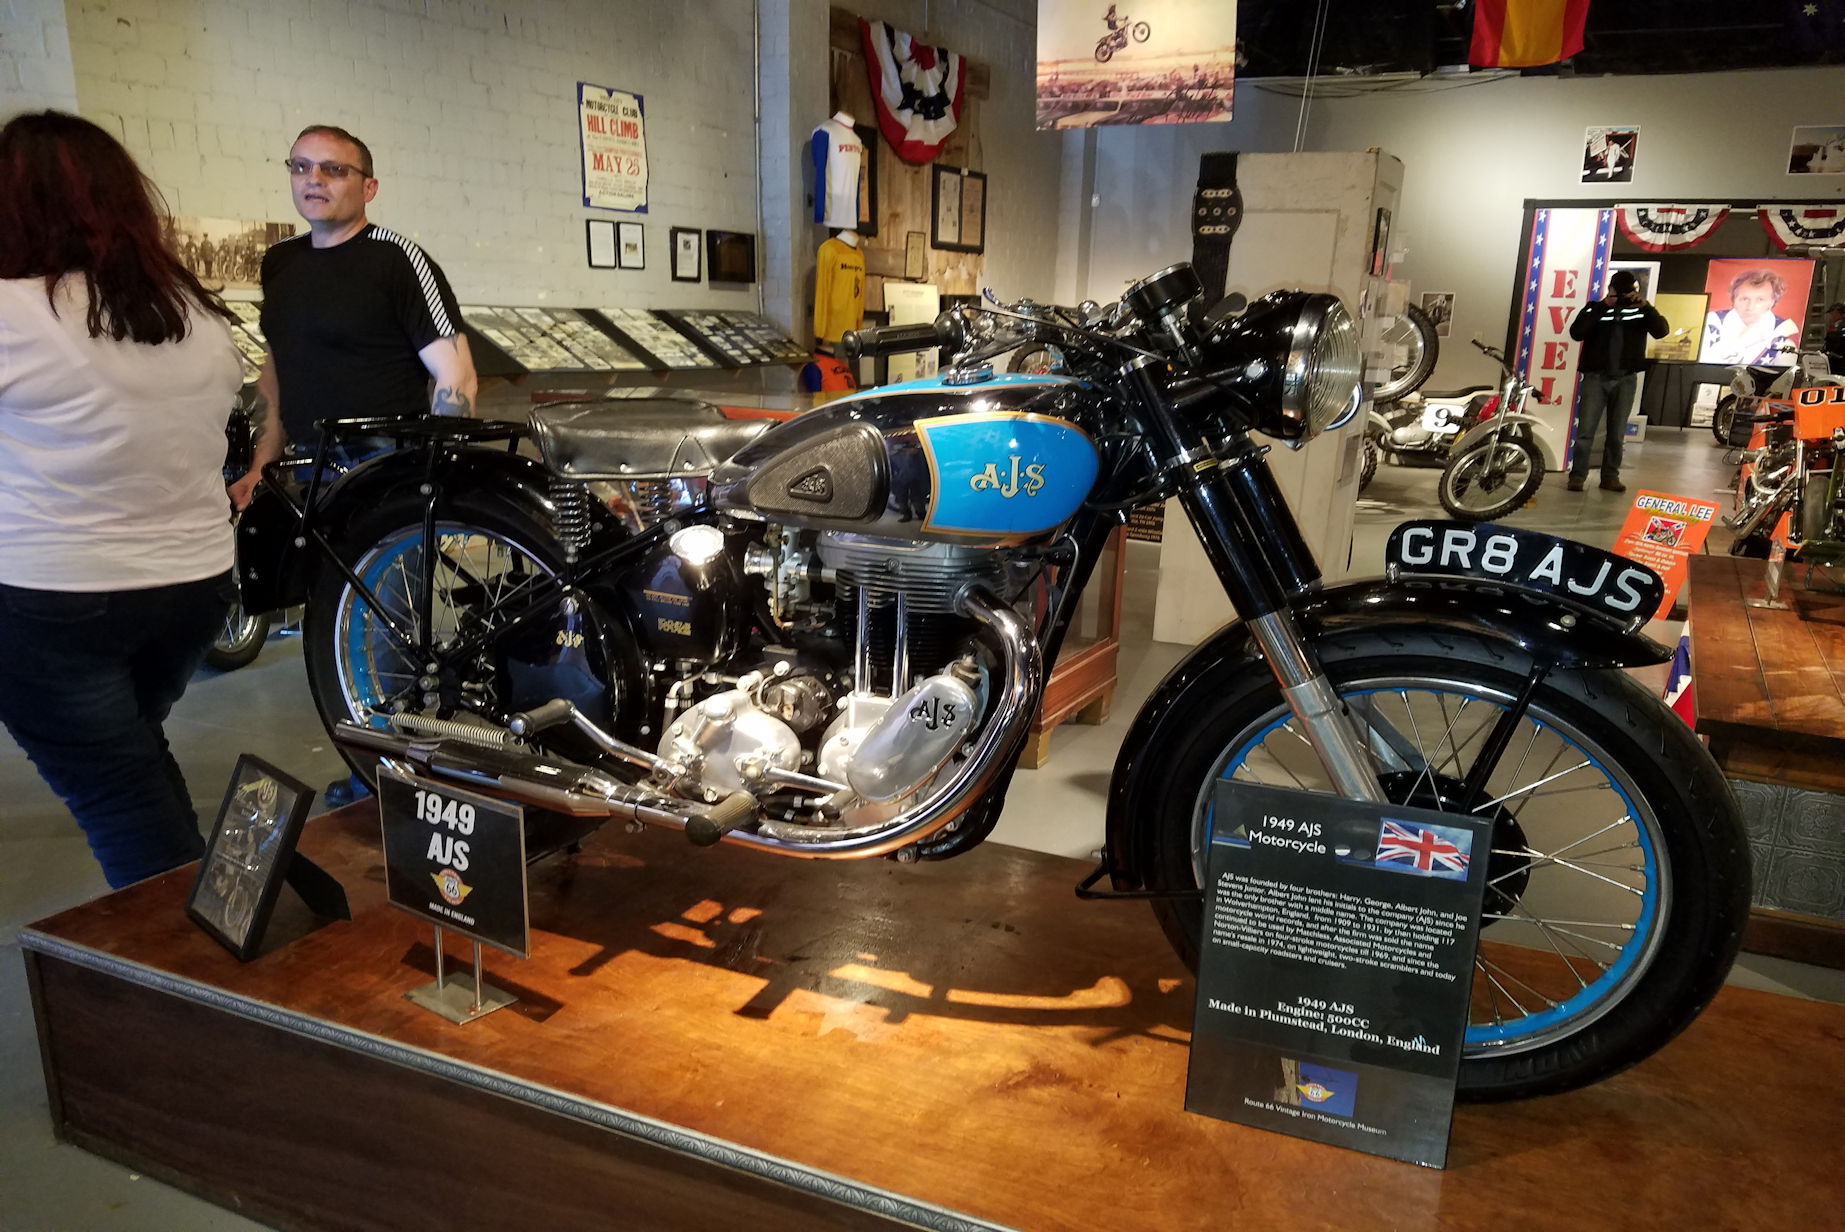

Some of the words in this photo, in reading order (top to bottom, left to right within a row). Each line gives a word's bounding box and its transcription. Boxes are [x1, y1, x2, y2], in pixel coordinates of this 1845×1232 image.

[587, 114, 607, 134] HILL
[610, 118, 639, 139] CLIMB
[622, 106, 638, 118] CLUB
[592, 153, 622, 175] MAY
[1538, 269, 1579, 406] EVEL
[1434, 407, 1452, 428] 9
[1636, 495, 1687, 515] GENERAL
[1689, 503, 1715, 521] LEE
[1401, 526, 1519, 574] GR8
[1528, 544, 1654, 612] AJS
[909, 695, 957, 731] AJS
[415, 790, 476, 835] 1949
[1262, 815, 1296, 832] 1949
[1298, 821, 1323, 837] AJS
[427, 832, 470, 871] AJS
[1248, 829, 1327, 856] Motorcycle
[1217, 880, 1243, 890] Stevens
[1268, 889, 1290, 899] Albert
[1291, 893, 1307, 902] John
[1323, 899, 1333, 907] his
[1367, 906, 1380, 915] the
[1381, 910, 1414, 923] company
[1416, 915, 1434, 925] (AJS)
[1435, 919, 1454, 928] since
[1222, 873, 1234, 882] AJS
[1235, 876, 1249, 884] was
[1249, 878, 1278, 889] founded
[1289, 885, 1304, 893] four
[1395, 903, 1419, 913] Albert
[1440, 912, 1454, 920] and
[1455, 913, 1468, 923] Joe
[429, 902, 443, 915] MADE
[443, 908, 451, 917] IN
[451, 909, 475, 926] ENGLAND
[1215, 905, 1253, 917] motorcycle
[1255, 913, 1275, 921] world
[1321, 924, 1337, 933] after
[1338, 927, 1350, 935] the
[1352, 929, 1367, 938] firm
[1368, 933, 1382, 941] was
[1384, 936, 1399, 944] sold
[1400, 938, 1412, 947] the
[1414, 942, 1434, 951] name
[1231, 891, 1242, 899] the
[1244, 894, 1258, 903] only
[1260, 896, 1286, 906] brother
[1288, 902, 1303, 910] with
[1311, 906, 1334, 915] middle
[1359, 913, 1374, 922] The
[1375, 918, 1408, 930] company
[1426, 925, 1453, 937] located
[1314, 913, 1332, 923] from
[1334, 917, 1352, 926] 1909
[1412, 931, 1440, 945] holding
[1441, 937, 1456, 946] 117
[1214, 913, 1248, 924] continued
[1268, 923, 1284, 931] used
[1333, 934, 1371, 948] Associated
[1373, 942, 1416, 956] Motorcycles
[1270, 948, 1302, 960] roadsters
[1316, 941, 1358, 954] motorcycles
[1392, 955, 1405, 963] and
[1407, 958, 1425, 967] since
[1427, 961, 1439, 969] the
[1380, 961, 1419, 974] scramblers
[1420, 969, 1434, 977] and
[1435, 971, 1456, 983] today
[1277, 1001, 1324, 1021] Engine:
[1327, 1013, 1370, 1030] 500CC
[1297, 996, 1327, 1011] 1949
[1329, 1000, 1355, 1015] AJS
[1208, 998, 1242, 1015] Made
[1244, 1004, 1257, 1017] in
[1259, 1007, 1329, 1034] Plumstead,
[1331, 1024, 1384, 1046] London,
[1387, 1035, 1441, 1056] England
[1244, 1097, 1265, 1110] Route
[1265, 1101, 1275, 1111] 66
[1276, 1104, 1301, 1118] Vintage
[1301, 1109, 1317, 1121] Iron
[1317, 1113, 1357, 1130] Motorcycle
[1357, 1122, 1388, 1136] Museum
